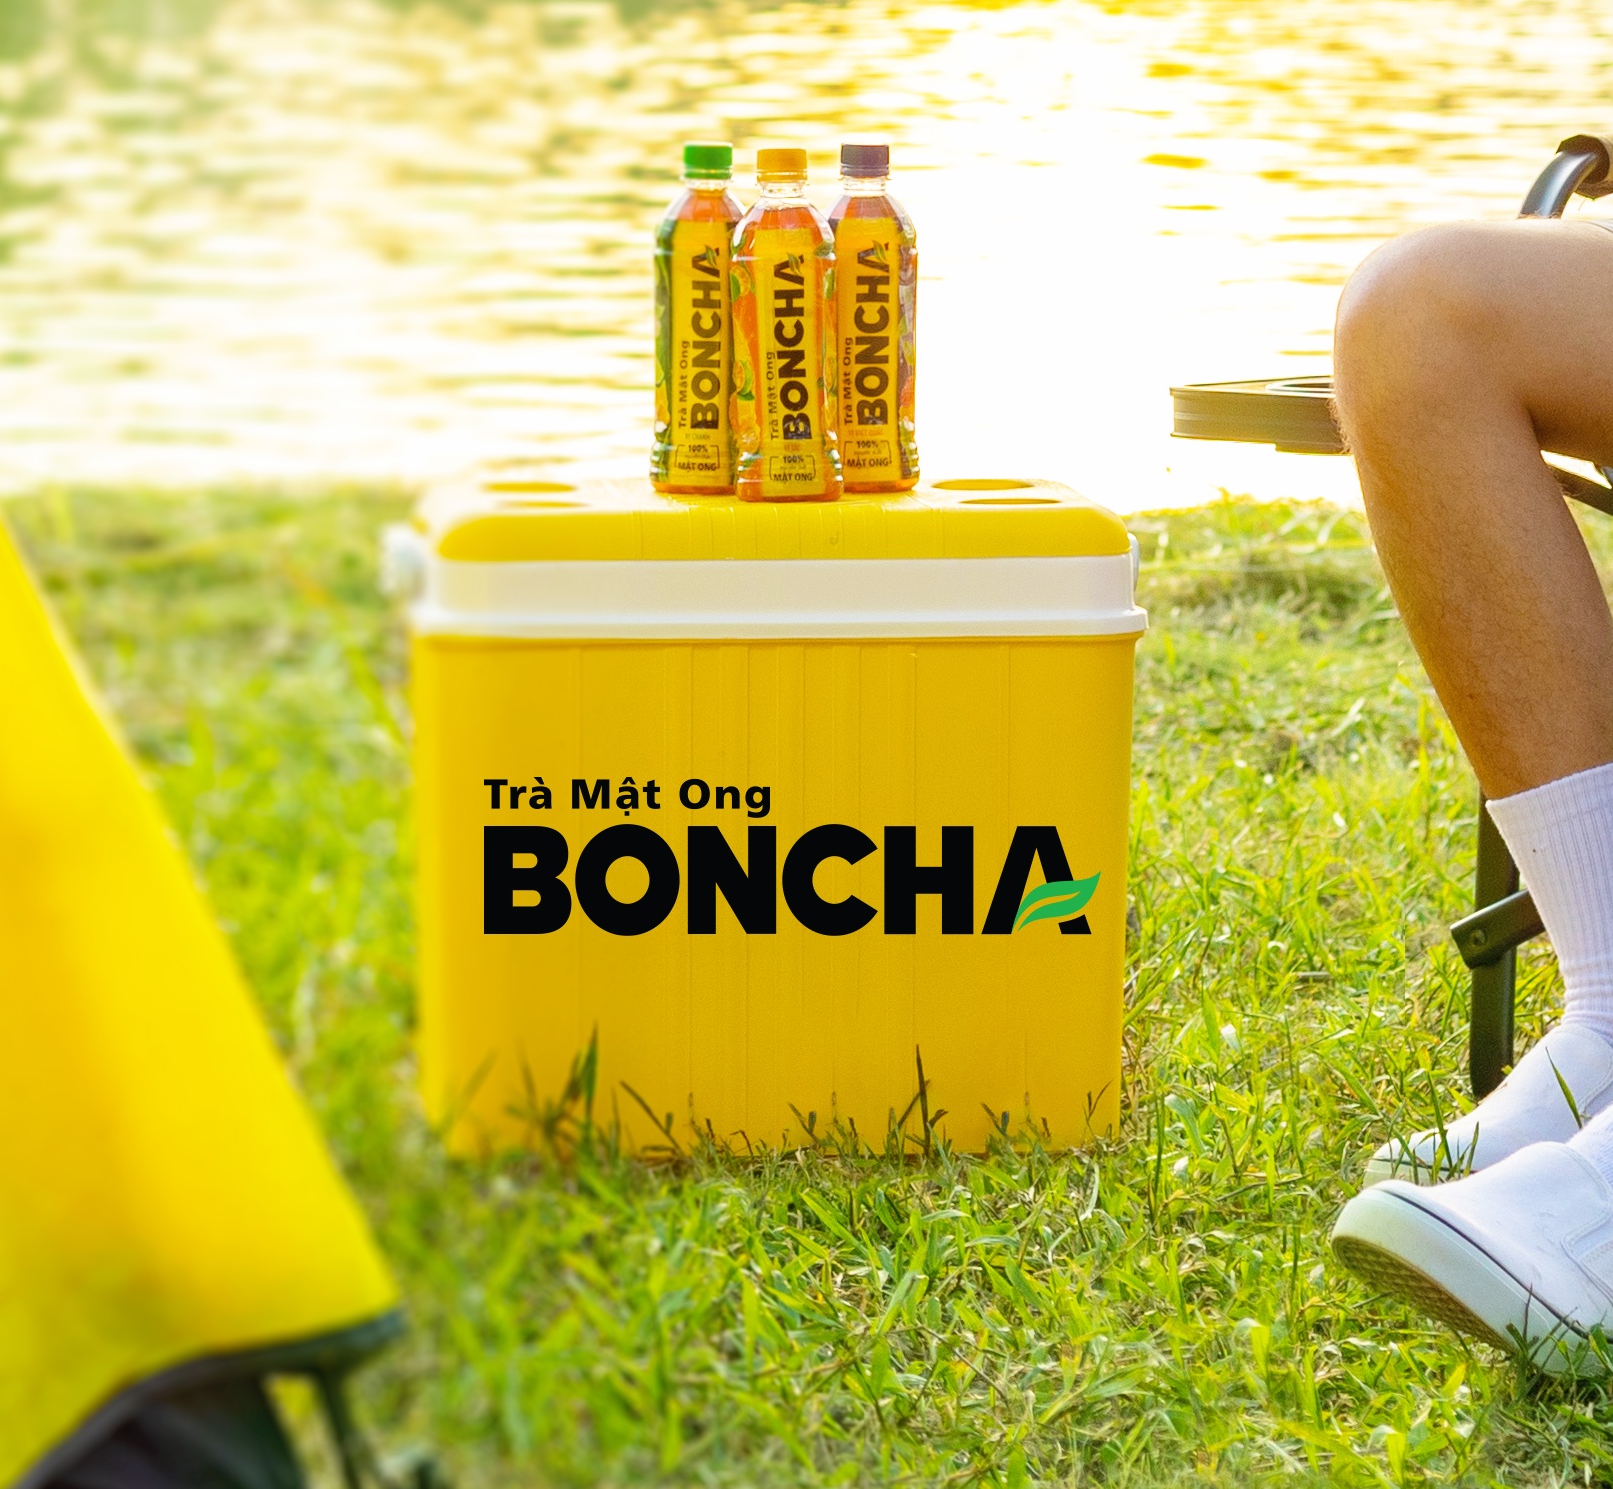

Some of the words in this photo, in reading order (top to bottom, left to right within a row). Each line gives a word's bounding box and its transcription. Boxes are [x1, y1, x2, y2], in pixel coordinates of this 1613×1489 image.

[690, 245, 721, 430] BONCHA
[774, 253, 812, 440] BONCHA
[854, 242, 890, 426] BONCHA
[679, 340, 690, 370] Ong
[765, 351, 776, 381] Ong
[843, 337, 853, 367] Ong
[677, 407, 688, 429] Trà
[769, 418, 779, 441] Trà
[843, 404, 853, 426] Trà
[697, 462, 717, 472] ONG
[794, 472, 813, 482] ONG
[868, 457, 889, 468] ONG
[484, 777, 553, 810] Trà
[570, 778, 661, 816] Mật
[678, 778, 772, 818] Ong
[483, 823, 1100, 937] BONCHA
